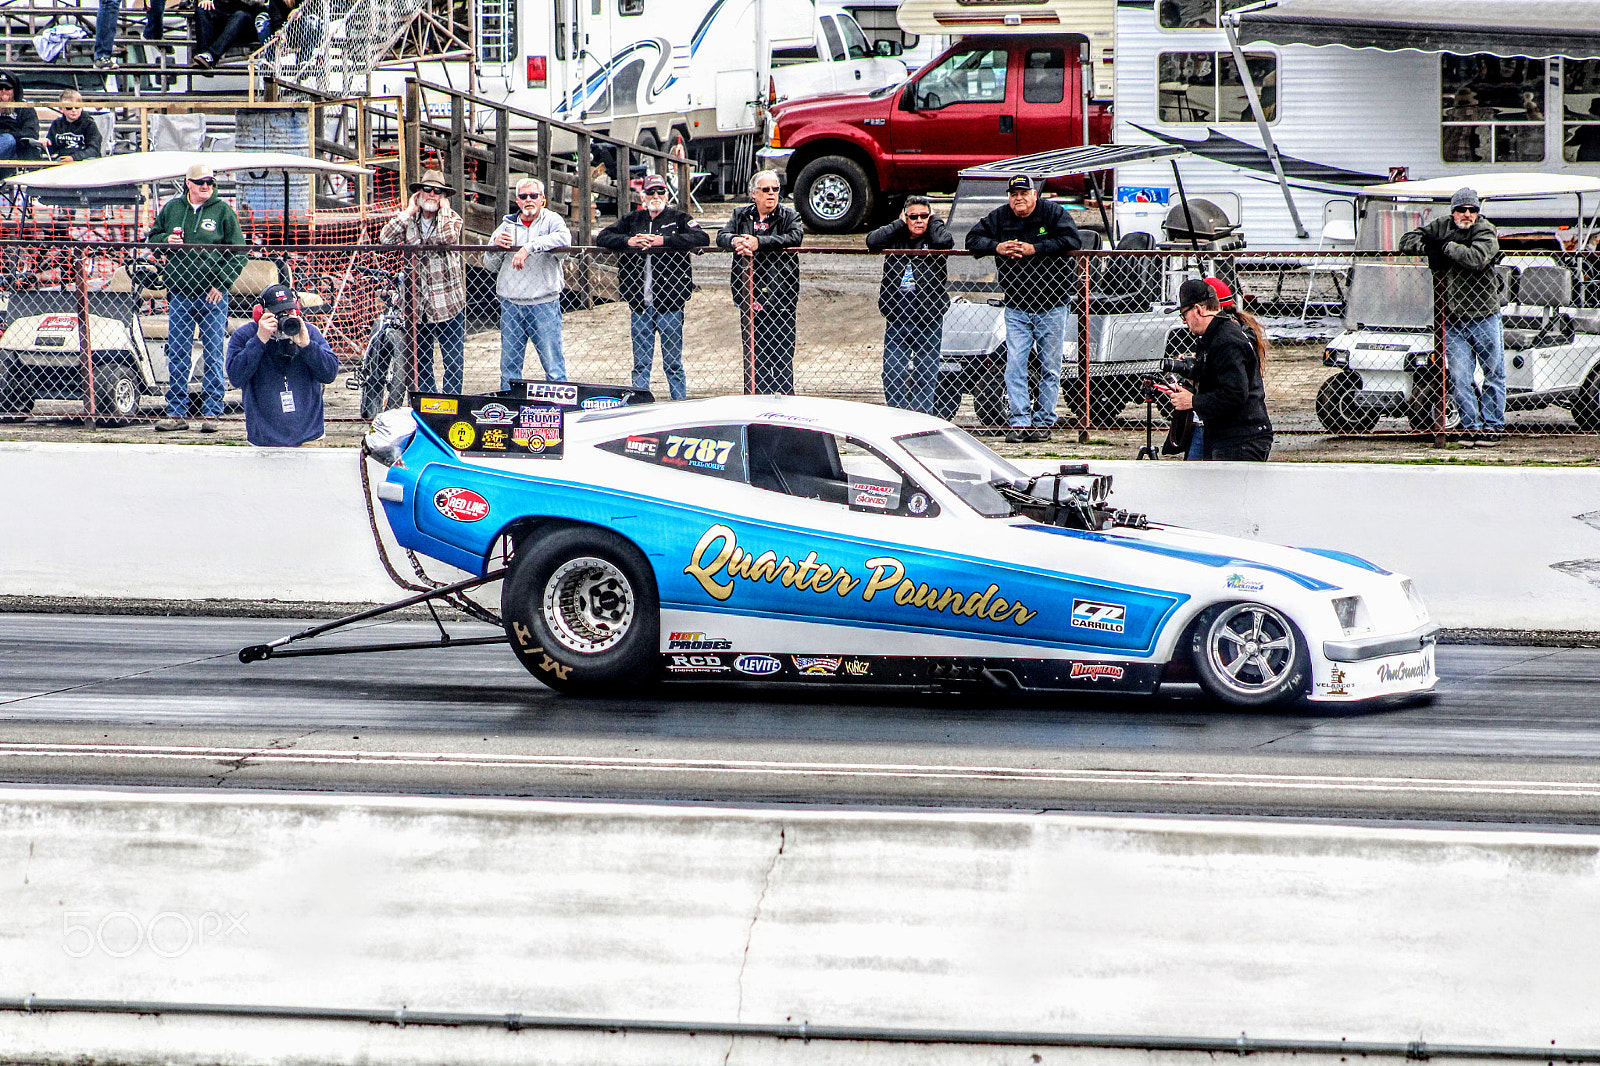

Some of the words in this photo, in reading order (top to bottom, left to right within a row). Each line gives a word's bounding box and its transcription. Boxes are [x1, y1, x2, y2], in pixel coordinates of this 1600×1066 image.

[527, 384, 577, 400] LENCO
[520, 414, 560, 423] TRUMP
[665, 434, 736, 465] 7787
[449, 496, 467, 510] RED
[466, 500, 487, 515] LINE
[684, 523, 860, 601] Quarter
[862, 556, 1038, 626] Pounder
[1072, 618, 1123, 632] CARRILLO
[669, 632, 704, 641] HOT
[668, 641, 733, 650] PROBES
[671, 655, 722, 667] RCD
[734, 656, 780, 674] CLEVITE
